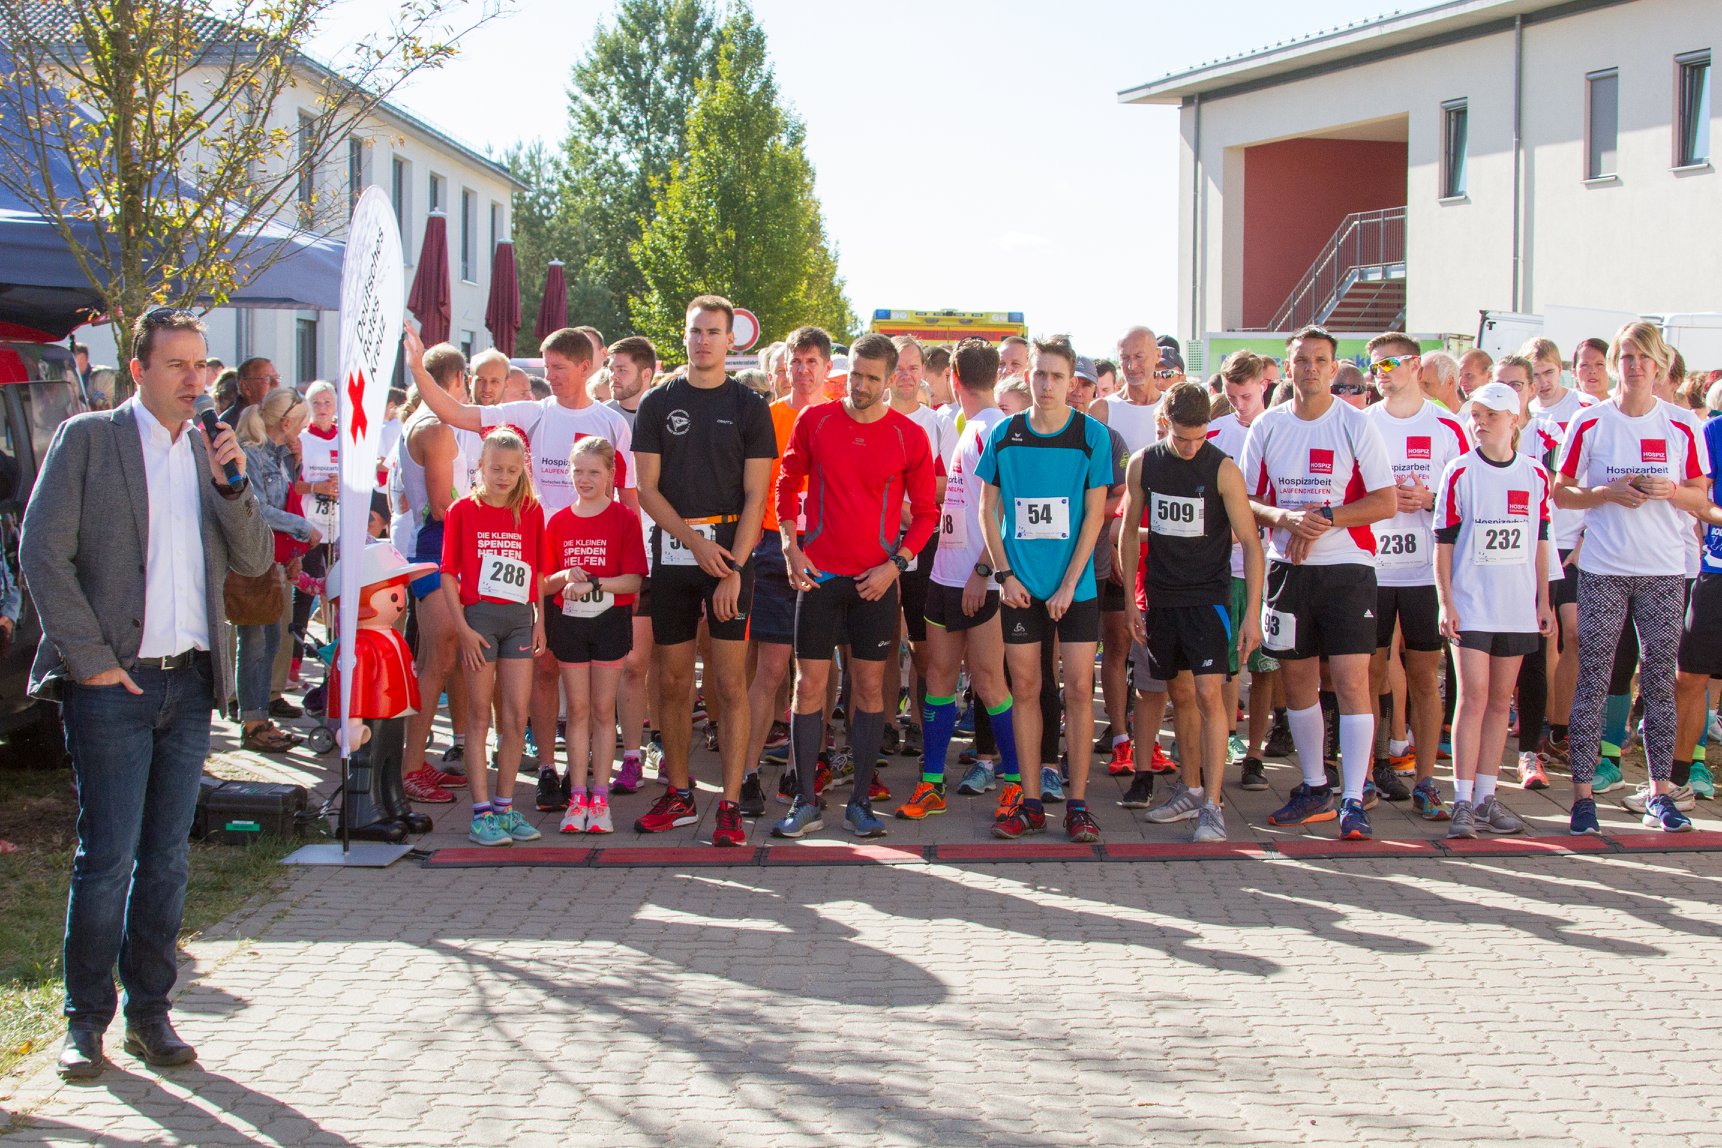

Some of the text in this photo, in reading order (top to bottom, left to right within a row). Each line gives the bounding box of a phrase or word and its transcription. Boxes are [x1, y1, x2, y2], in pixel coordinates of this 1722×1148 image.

[357, 226, 384, 343] Deutsches
[363, 296, 380, 363] Rotes
[369, 317, 387, 382] Kreuz
[1391, 463, 1430, 472] pizarbeit
[1606, 466, 1669, 474] Hospizarbeit
[1278, 477, 1331, 486] Hospizarbeit
[1028, 504, 1052, 524] 54
[1158, 500, 1194, 523] 509
[477, 540, 522, 549] SPENDEN
[491, 532, 522, 540] KLEINEN
[1380, 534, 1417, 555] 238
[1485, 529, 1521, 550] 232
[564, 547, 606, 556] SPENDEN
[564, 556, 606, 567] HELFEN
[490, 561, 525, 587] 288
